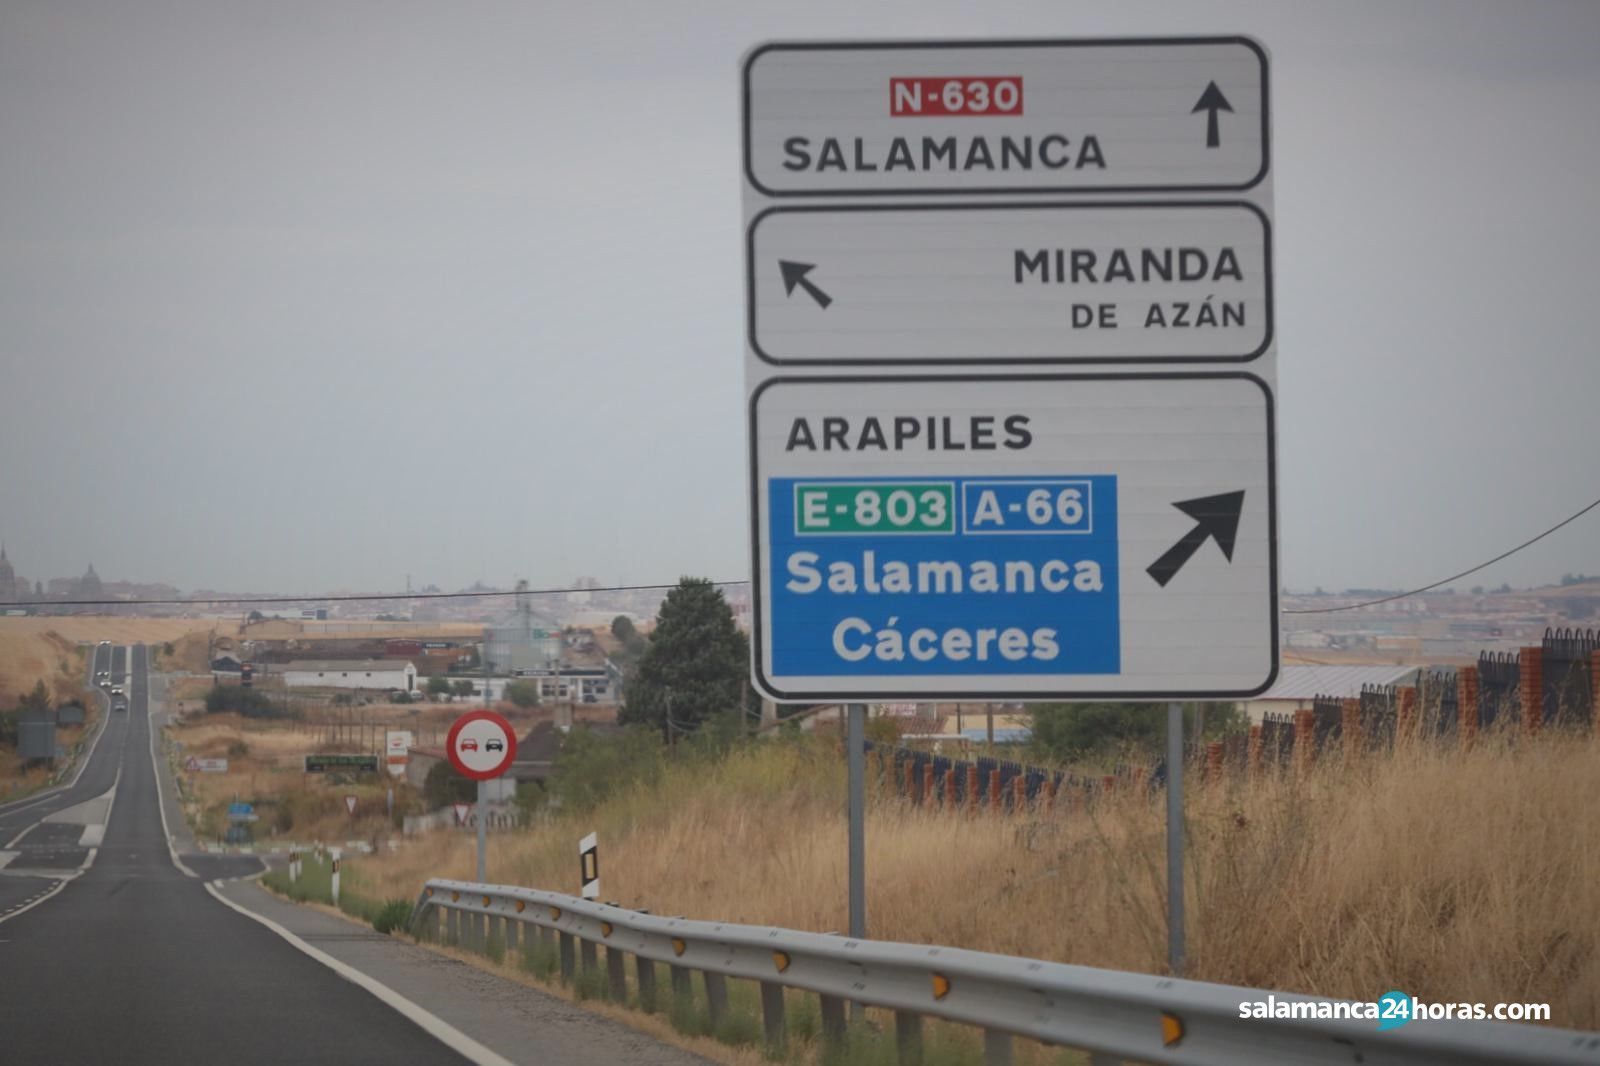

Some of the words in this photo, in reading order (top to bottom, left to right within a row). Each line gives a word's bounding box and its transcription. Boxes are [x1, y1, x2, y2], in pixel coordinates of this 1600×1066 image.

[894, 81, 1019, 112] N-630
[782, 135, 1107, 171] SALAMANCA
[1014, 248, 1243, 283] MIRANDA
[1071, 304, 1118, 329] DE
[1144, 294, 1246, 328] AZÁN
[785, 415, 1033, 451] ARAPILES
[802, 490, 947, 527] E-803
[972, 489, 1083, 526] A-66
[786, 550, 1104, 594] Salamanca
[832, 617, 1060, 661] Cáceres
